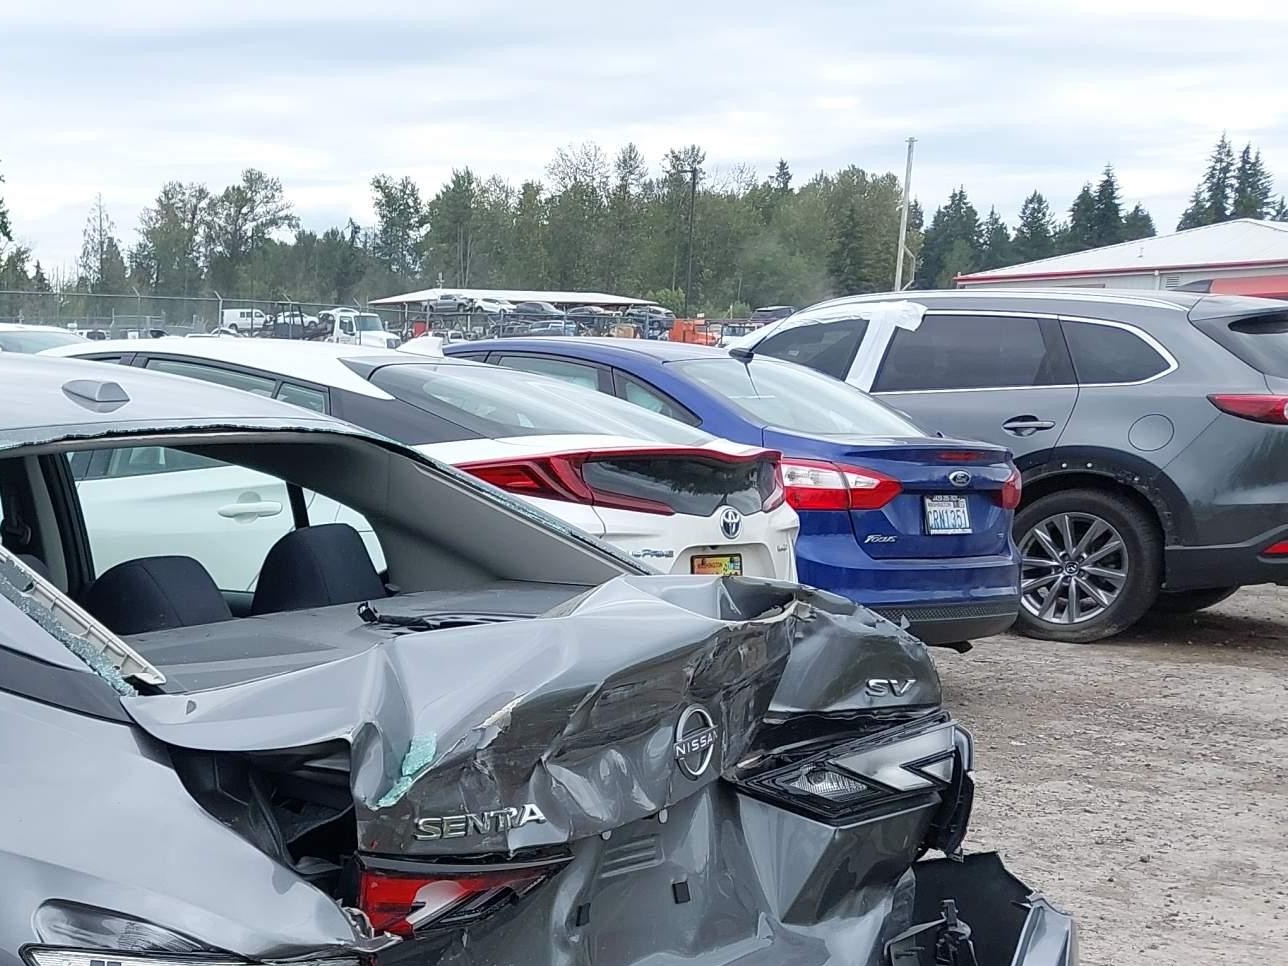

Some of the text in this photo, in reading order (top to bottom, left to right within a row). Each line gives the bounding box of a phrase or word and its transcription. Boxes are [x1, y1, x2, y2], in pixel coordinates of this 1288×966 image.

[864, 678, 917, 697] SV
[675, 730, 719, 757] NISSAN
[412, 803, 546, 840] SENTRA
